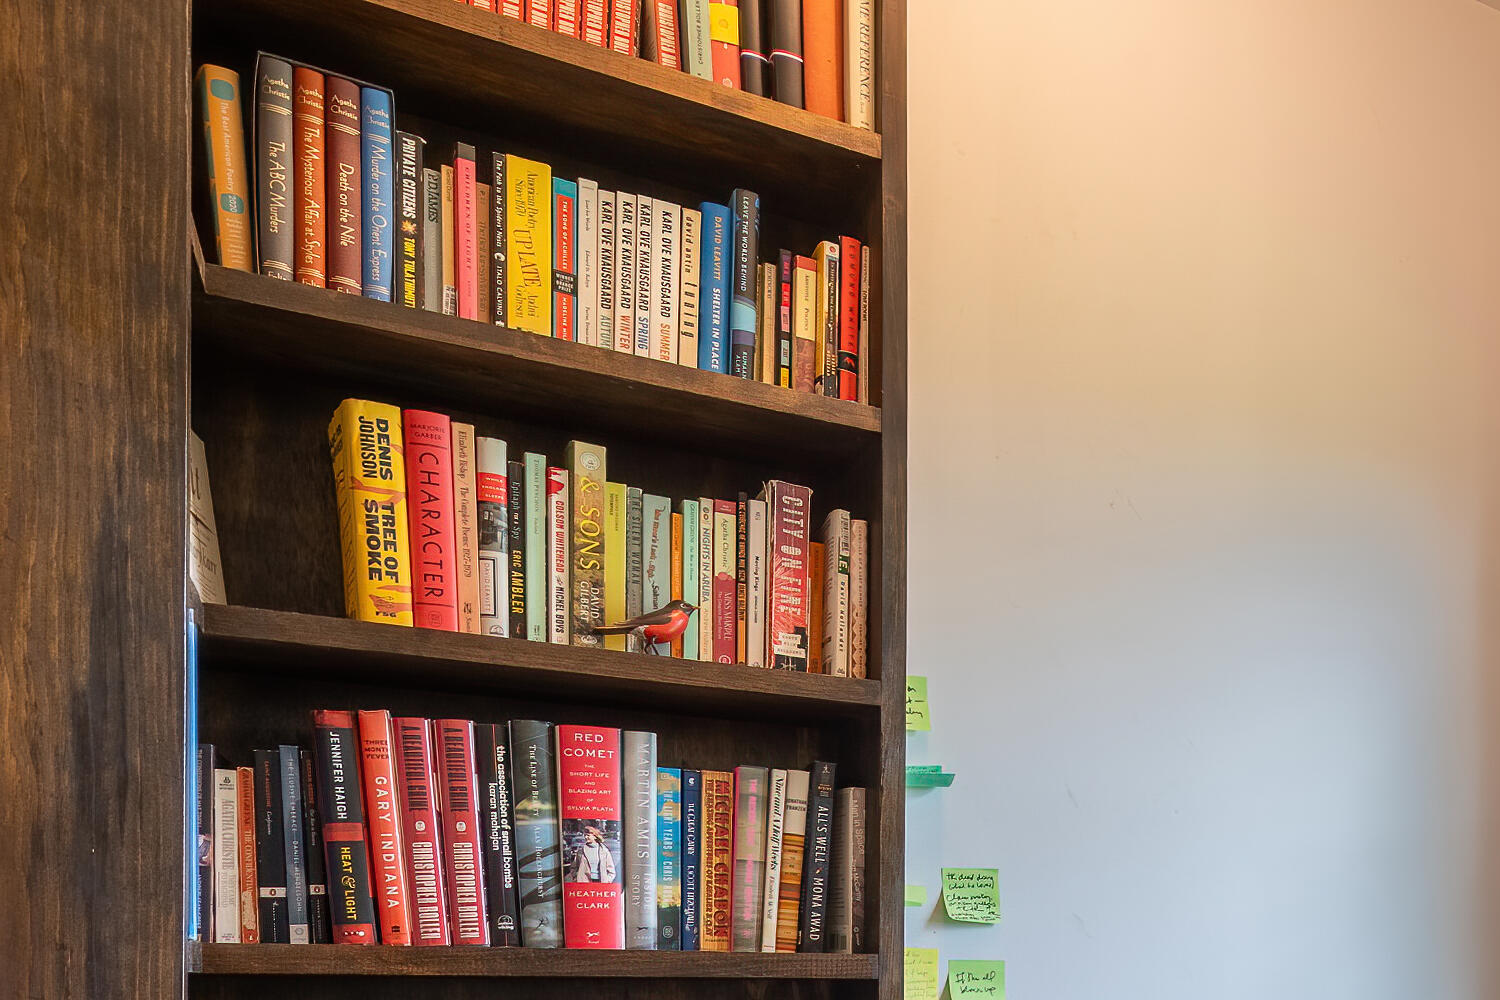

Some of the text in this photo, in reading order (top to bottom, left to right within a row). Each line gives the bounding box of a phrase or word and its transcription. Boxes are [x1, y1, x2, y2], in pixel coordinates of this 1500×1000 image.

[859, 23, 872, 102] REFERENCE
[269, 142, 286, 234] The ABC Murders
[339, 163, 355, 247] Death on the Nile
[403, 137, 417, 219] PRIVATE CITIZENS
[619, 200, 634, 350] KARL OVE KNAUSGAARD WINTER
[638, 203, 651, 350] KARL OVE KNAUSGAARD SPRING
[659, 210, 673, 361] KARL OVE KNAUSGAARD SUMMER
[713, 215, 723, 281] DAVID LEAVITT
[711, 287, 722, 371] SHELTER IN PLACE
[358, 416, 378, 479] JOHNSON
[375, 417, 394, 481] DENIS
[363, 498, 383, 582] SMOKE
[380, 501, 400, 584] TREE OF
[418, 451, 445, 599] CHARACTER
[556, 500, 565, 573] COLSON WHITEHEAD
[781, 544, 803, 569] ON
[782, 495, 804, 539] CITY
[511, 550, 525, 614] ERIC AMBLER
[580, 581, 591, 622] GILBERT
[589, 587, 600, 619] DAVID
[702, 527, 711, 603] NIGHTS IN ARUBA
[779, 575, 802, 616] FIRE
[329, 731, 348, 820] JENNIFER HAIGH
[564, 748, 614, 759] COMET
[574, 732, 604, 743] RED
[488, 782, 502, 851] karan mahajan
[636, 743, 650, 859] MARTIN AMIS
[375, 775, 400, 909] GARY INDIANA
[713, 779, 730, 938] MICHAEL CHABON
[809, 805, 830, 942] ALL'S WELL MONA AWAD
[412, 841, 442, 940] CHRISTOPHER BOLLEN
[453, 841, 481, 939] CHRISTOPHER BOLLEN
[569, 890, 617, 899] HEATHER
[576, 902, 610, 910] CLARK
[631, 873, 641, 907] STORY
